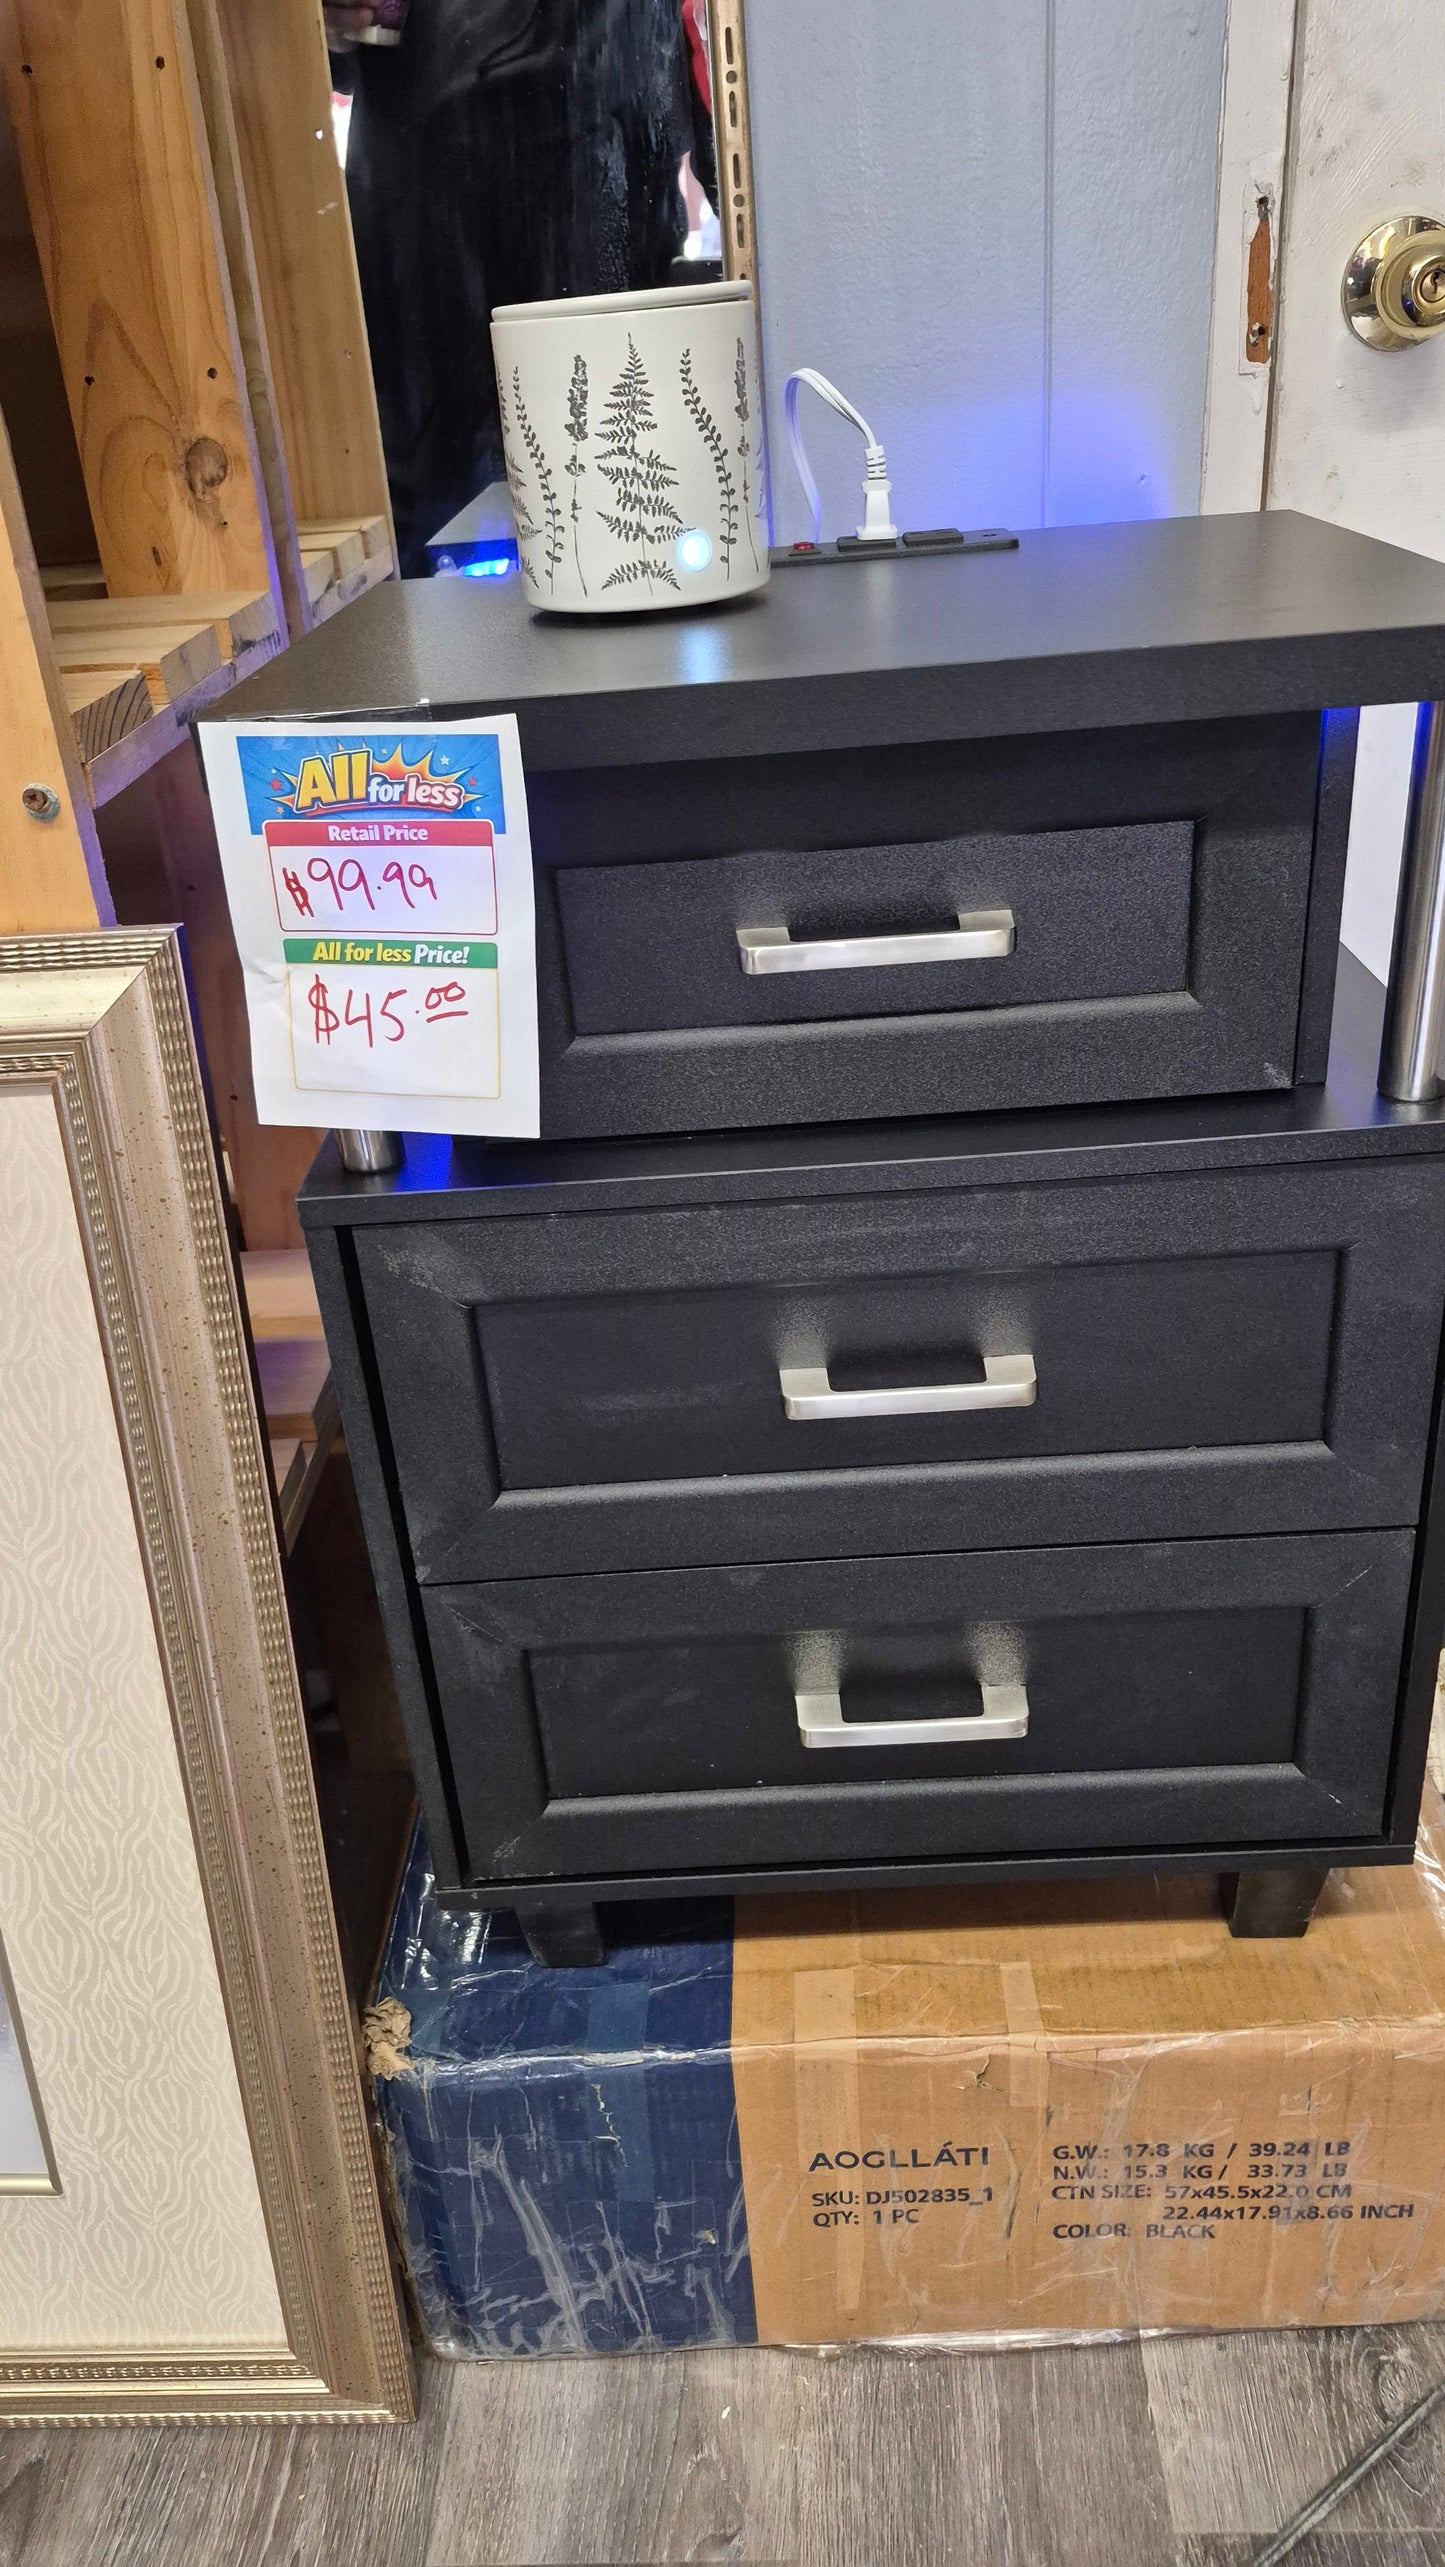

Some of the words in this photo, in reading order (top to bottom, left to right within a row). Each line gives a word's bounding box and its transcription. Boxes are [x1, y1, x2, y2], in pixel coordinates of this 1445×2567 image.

[296, 750, 371, 809] All
[368, 777, 404, 801] for
[406, 775, 462, 808] less
[329, 825, 380, 842] Retail
[384, 825, 428, 841] Price
[282, 857, 438, 917] $99.99
[313, 941, 341, 961] All
[344, 942, 374, 961] for
[376, 941, 411, 963] less
[414, 944, 469, 965] Price!
[308, 974, 469, 1047] $45.00
[808, 2141, 989, 2172] AOGLLÁTI
[1123, 2143, 1170, 2158] 17.8
[1184, 2143, 1215, 2158] KG
[1227, 2143, 1237, 2159] /
[1249, 2142, 1311, 2158] 39.24
[1324, 2141, 1351, 2156] LB
[1123, 2164, 1168, 2179] 15.3
[1183, 2164, 1213, 2179] KG
[1247, 2163, 1307, 2179] 33.73
[1322, 2162, 1347, 2177] LB
[811, 2190, 860, 2207] SKU:
[866, 2187, 993, 2207] DJ502835_1
[1051, 2185, 1095, 2200] CTN
[1101, 2184, 1152, 2200] SIZE:
[1316, 2183, 1352, 2199] CM
[813, 2210, 859, 2228] QTY:
[874, 2210, 882, 2224] 1
[892, 2209, 919, 2224] PC
[1360, 2203, 1414, 2219] INCH
[1053, 2223, 1131, 2239] COLOR:
[1146, 2223, 1216, 2239] BLACK
